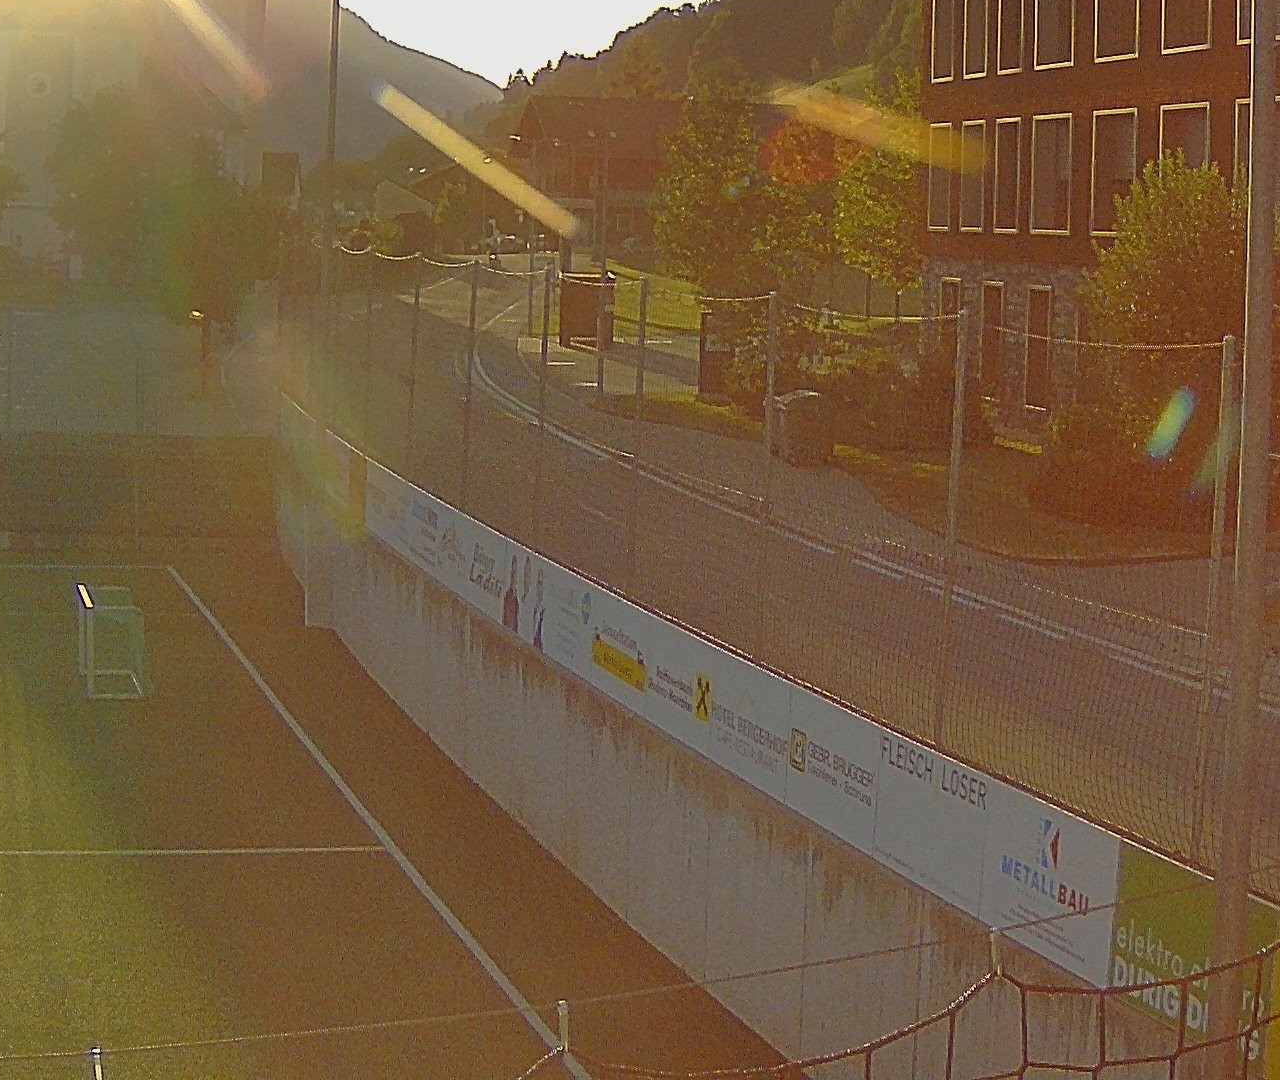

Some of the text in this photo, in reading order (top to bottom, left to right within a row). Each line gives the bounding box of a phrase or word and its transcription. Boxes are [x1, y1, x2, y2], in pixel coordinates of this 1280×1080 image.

[881, 735, 988, 811] FLEISCH LOSER
[1001, 854, 1089, 917] METALLBAU
[1116, 918, 1183, 977] elektro
